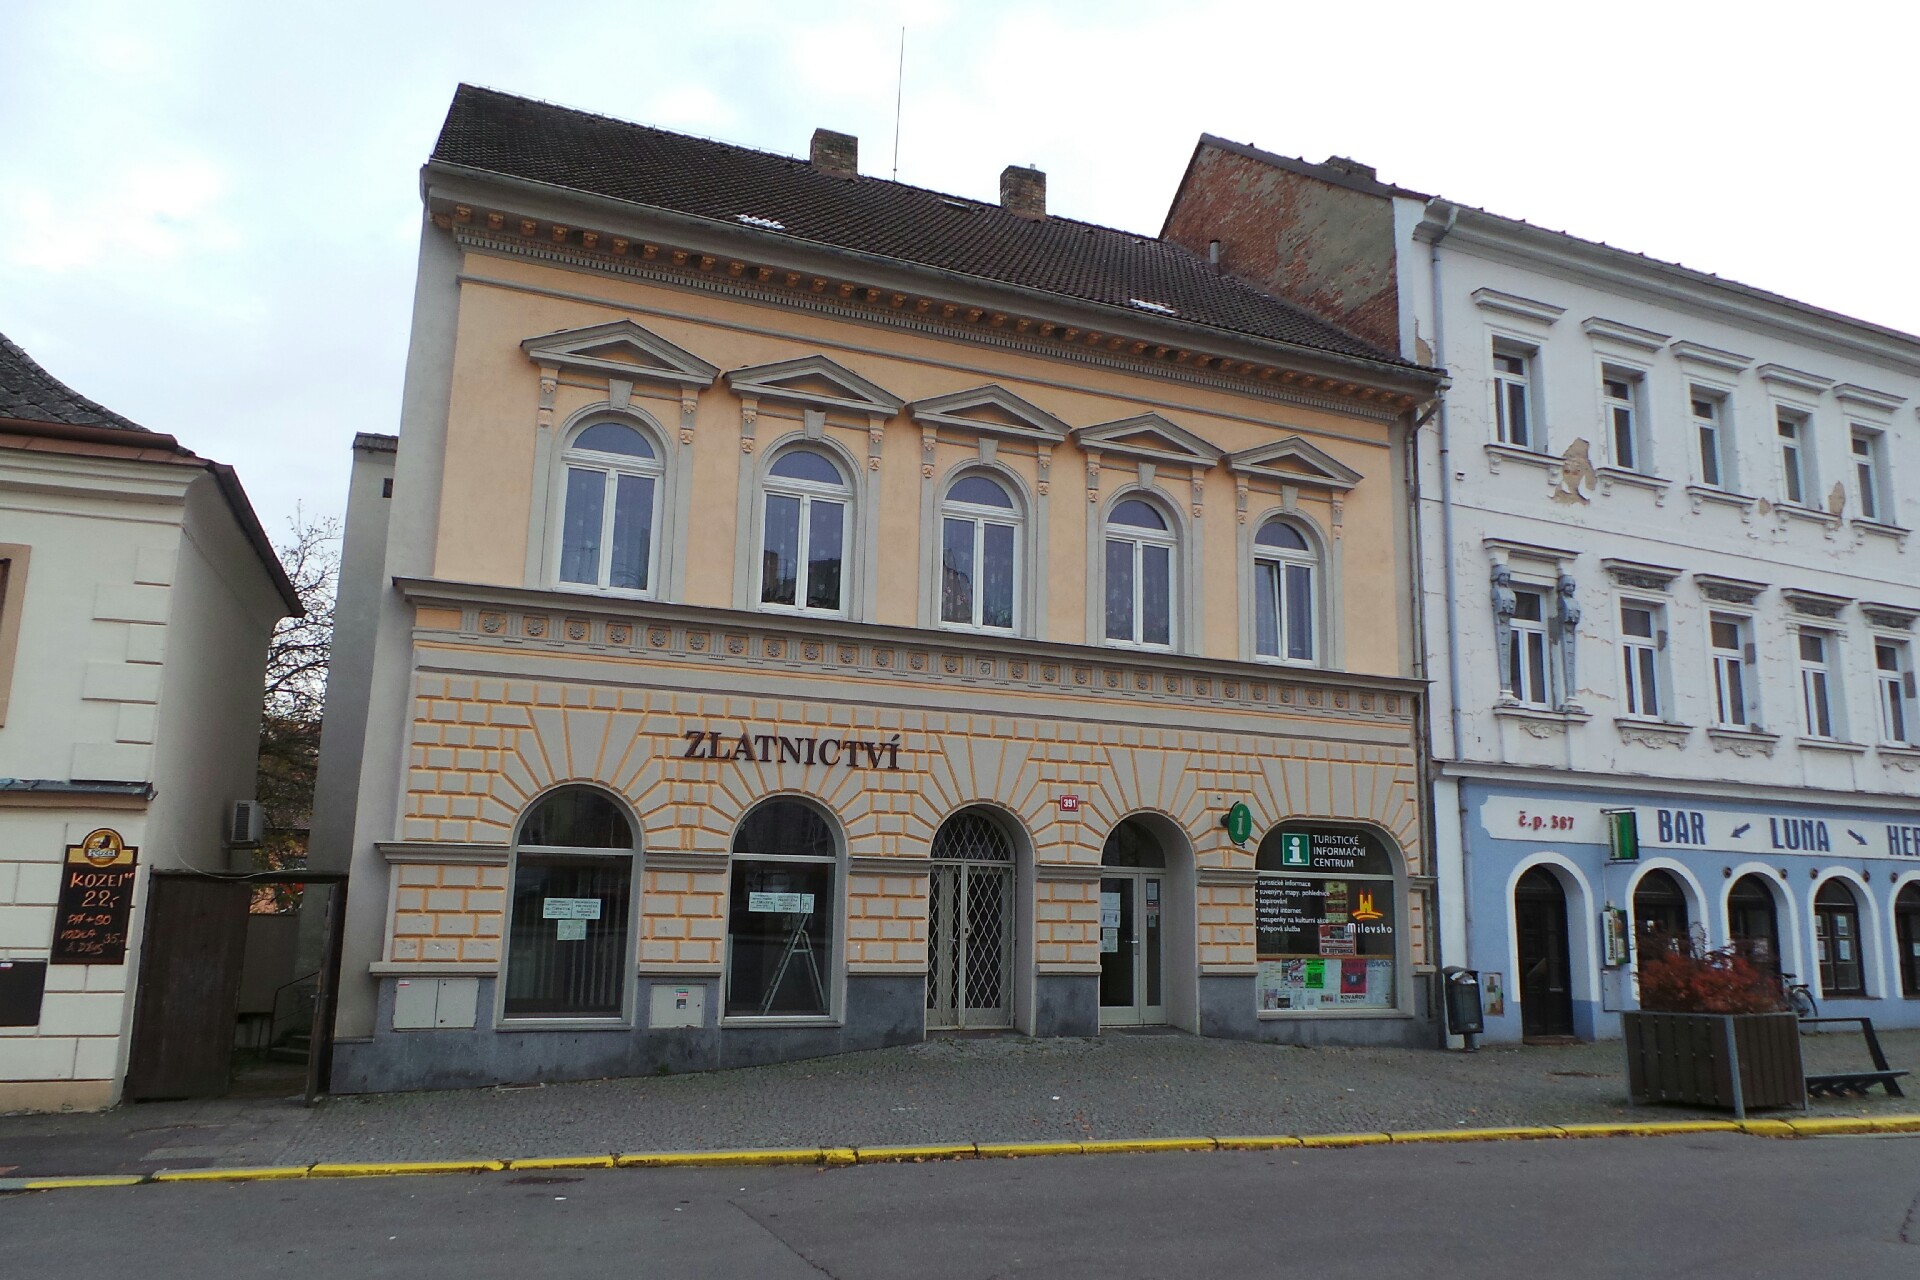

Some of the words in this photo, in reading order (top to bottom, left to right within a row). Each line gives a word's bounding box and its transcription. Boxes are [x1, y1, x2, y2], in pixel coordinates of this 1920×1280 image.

[684, 730, 900, 770] ZLATNICTVÍ
[1063, 798, 1077, 808] 391
[1519, 810, 1547, 830] č.p.
[1657, 809, 1706, 845] BAR
[1313, 834, 1359, 845] TURISTICKÉ
[1769, 817, 1831, 852] LUNA
[1313, 846, 1366, 857] INFORMAČNÍ
[1313, 858, 1354, 868] CENTRUM
[1260, 907, 1279, 915] veřejný
[1347, 922, 1393, 934] Milevsko
[1608, 918, 1616, 961] STAROPRAMEN
